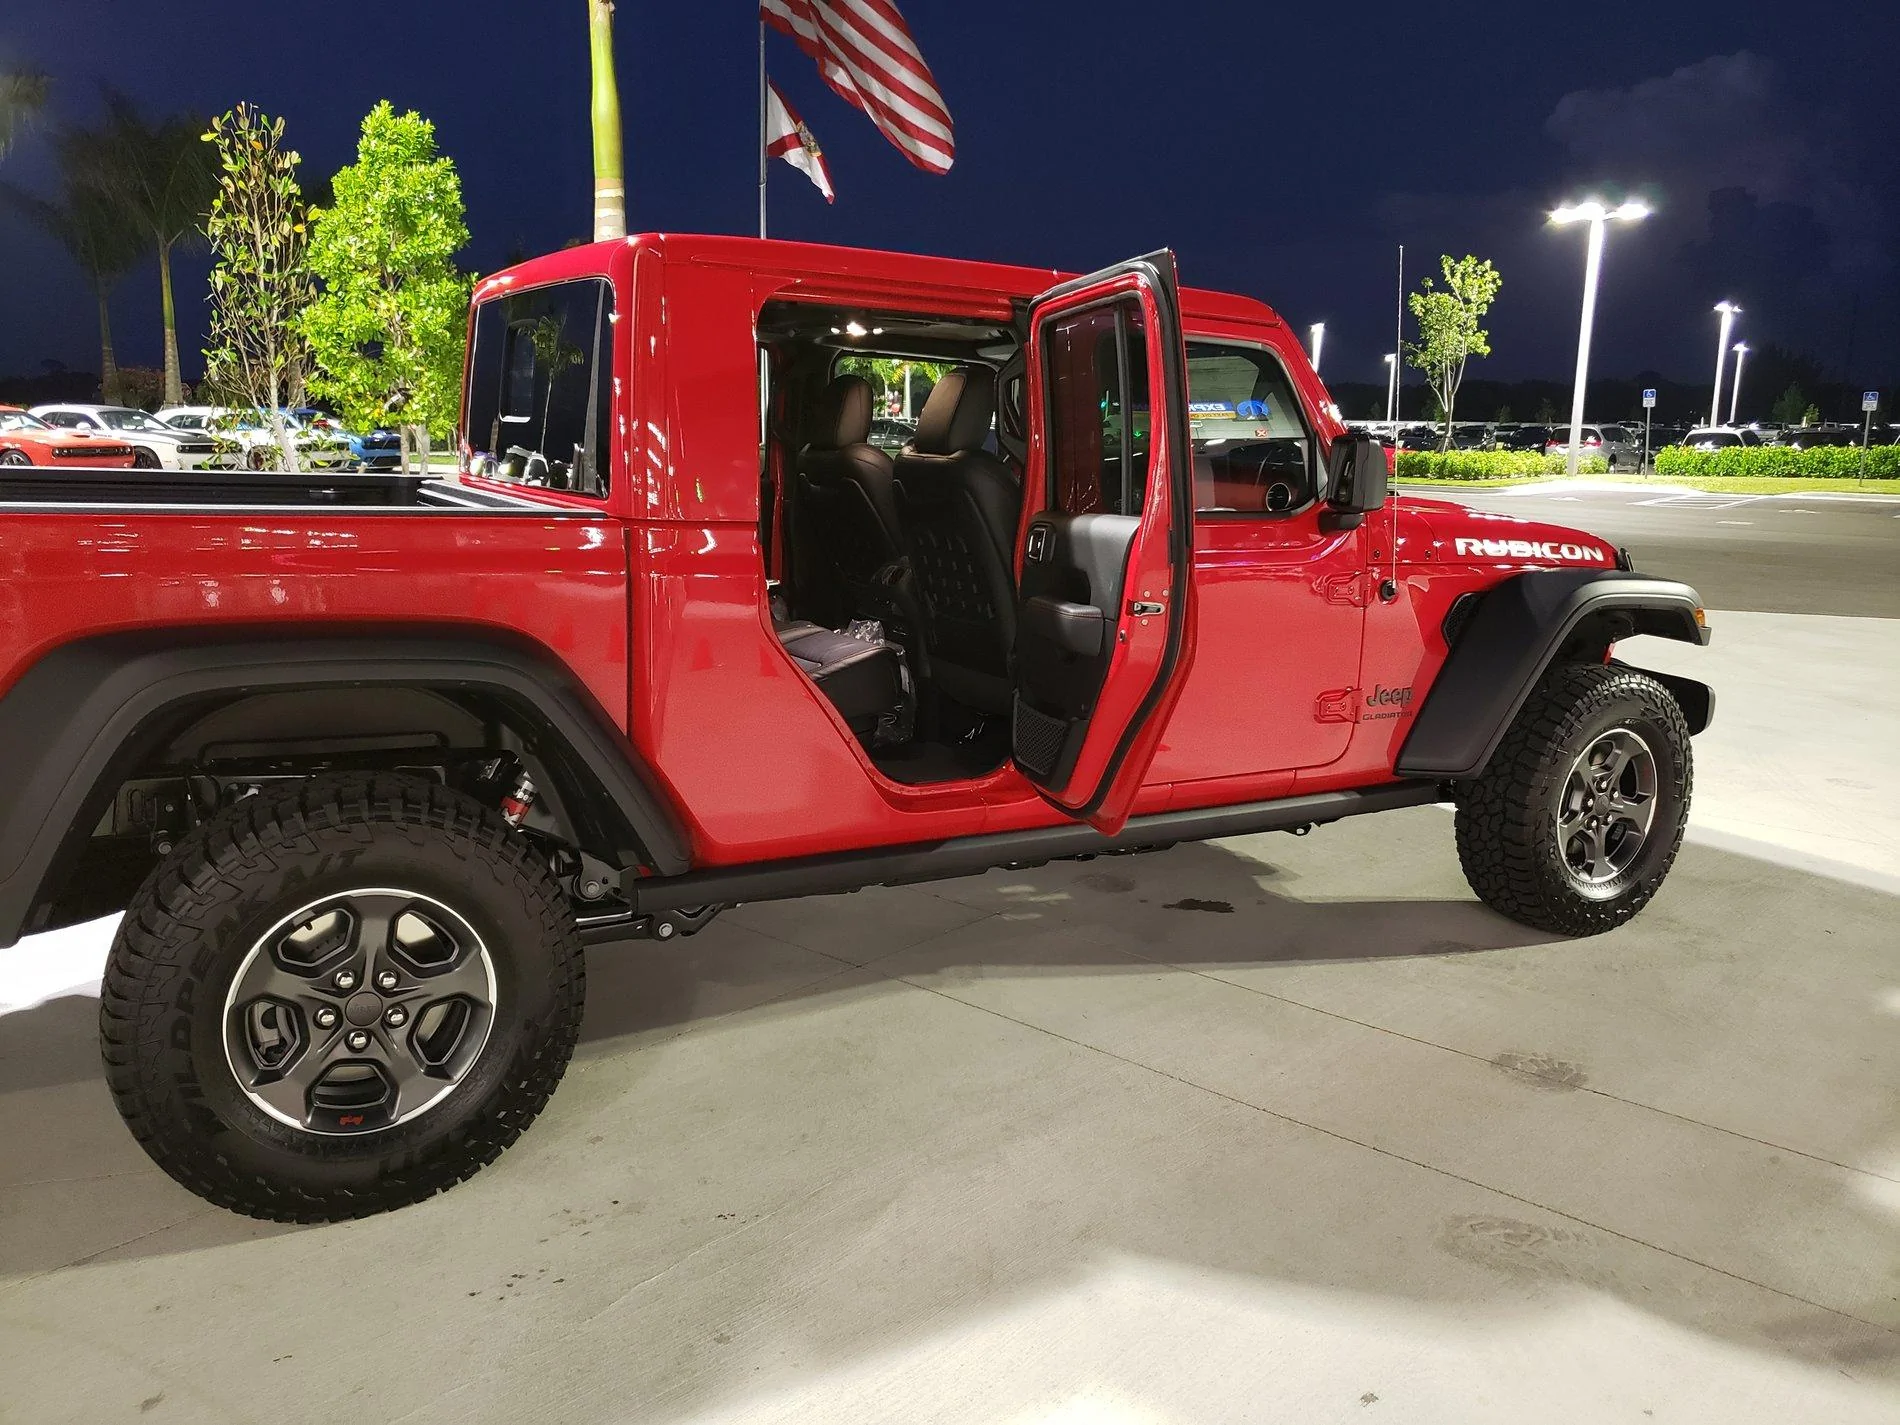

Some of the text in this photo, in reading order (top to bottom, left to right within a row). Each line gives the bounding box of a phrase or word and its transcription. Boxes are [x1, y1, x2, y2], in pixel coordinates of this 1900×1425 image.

[1455, 538, 1604, 562] RUBICON
[1366, 684, 1412, 708] Jeep
[1362, 711, 1412, 721] GLADIATOR
